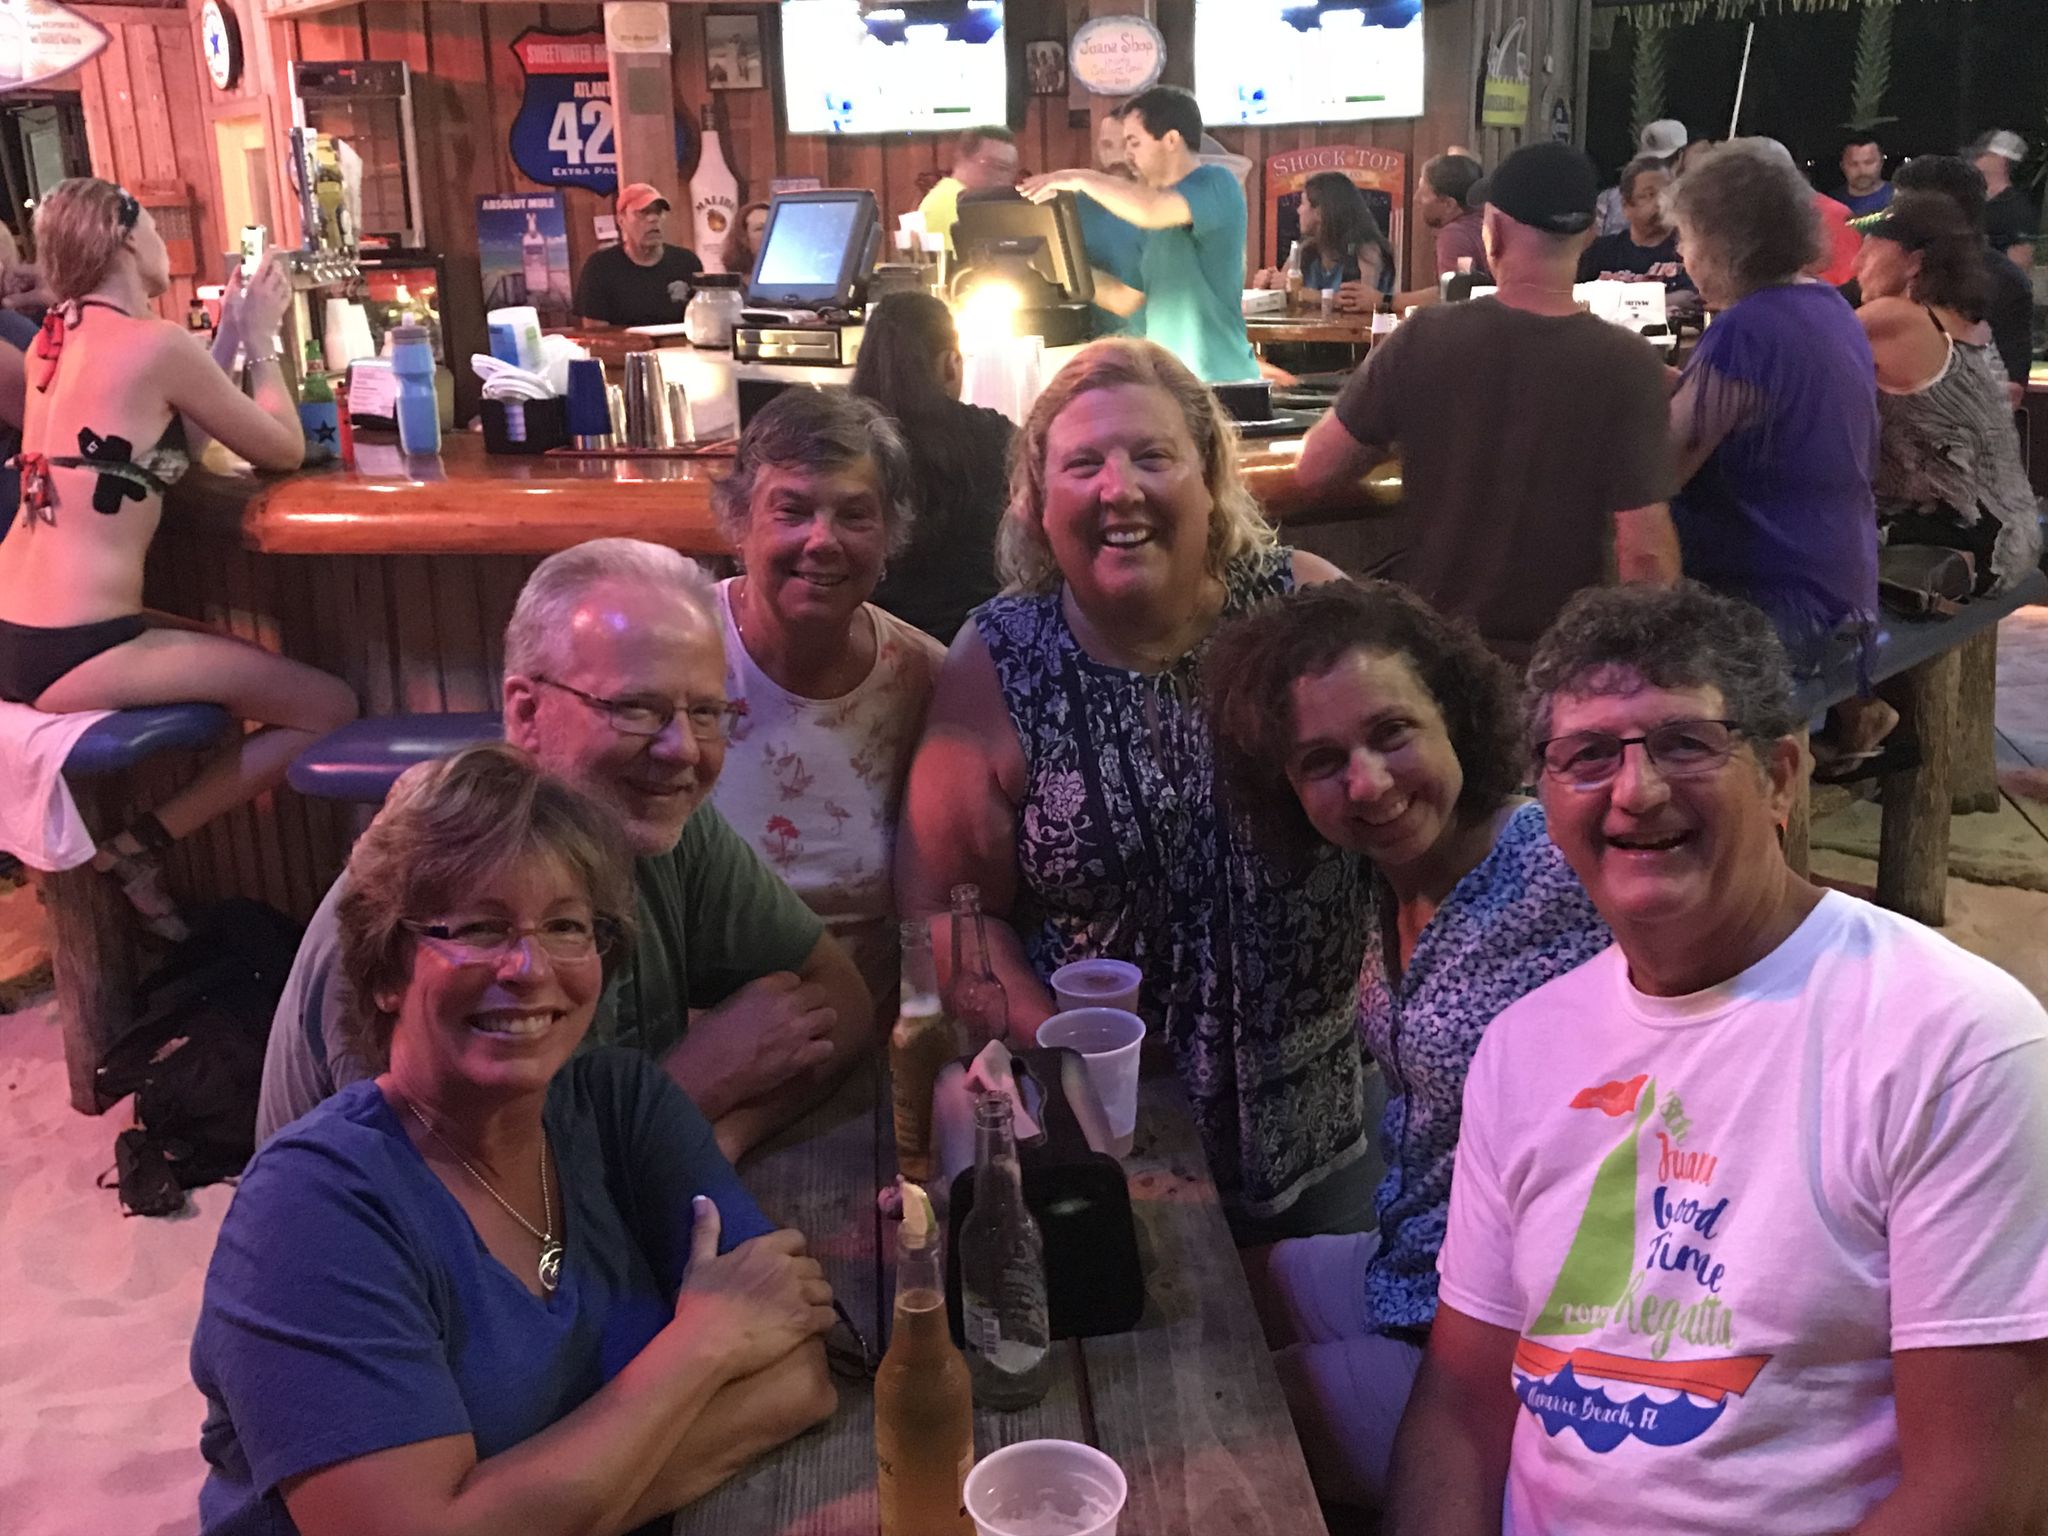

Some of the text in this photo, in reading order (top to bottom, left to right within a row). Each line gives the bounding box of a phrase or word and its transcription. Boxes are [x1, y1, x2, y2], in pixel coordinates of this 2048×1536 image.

[1273, 150, 1399, 177] SHOCK TOP
[482, 199, 526, 210] ABSOLUT
[1654, 1186, 1730, 1240] Good
[1646, 1231, 1725, 1293] Time
[1614, 1271, 1733, 1360] Regatta
